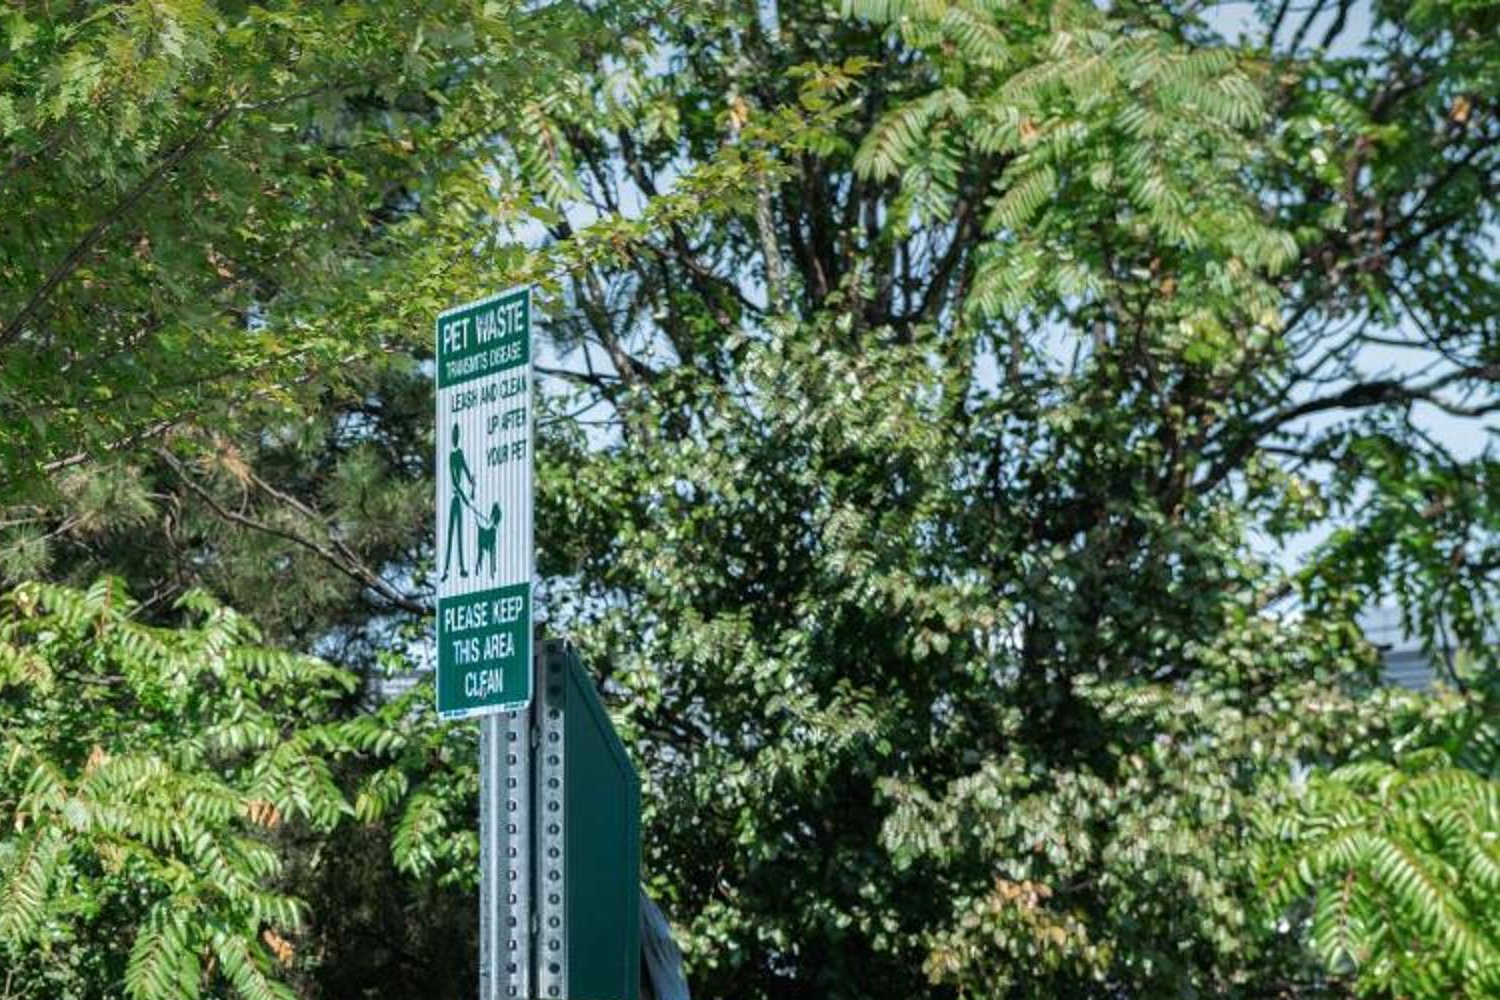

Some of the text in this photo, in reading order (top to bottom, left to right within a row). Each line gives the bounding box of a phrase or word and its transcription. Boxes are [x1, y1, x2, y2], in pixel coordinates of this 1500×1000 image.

[443, 299, 524, 354] PET WASTE
[489, 340, 522, 368] DISEASE
[452, 376, 526, 412] LEASH AND CLEAN
[487, 407, 526, 435] UP AFTER
[486, 439, 526, 467] YOUR PET
[444, 595, 523, 633] PLEASE KEEP
[452, 631, 515, 665] THIS AREA
[465, 667, 503, 699] CLEAN
